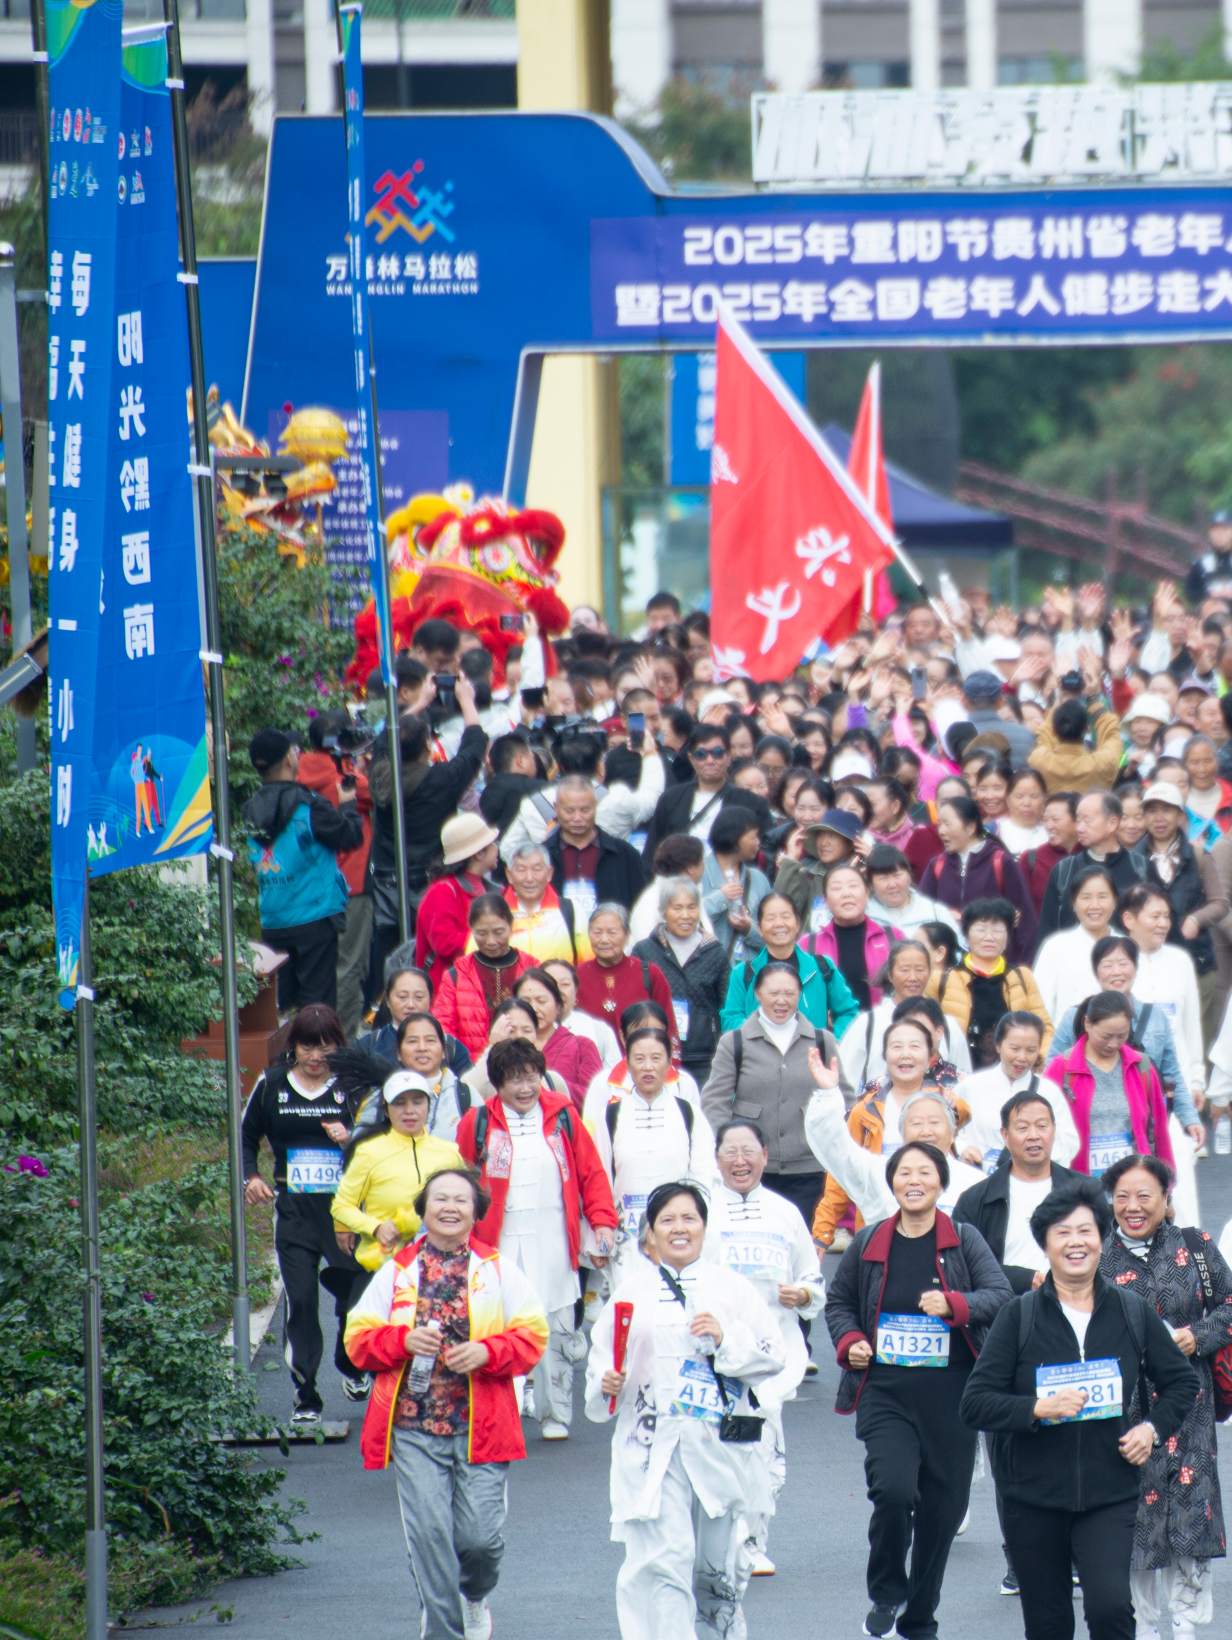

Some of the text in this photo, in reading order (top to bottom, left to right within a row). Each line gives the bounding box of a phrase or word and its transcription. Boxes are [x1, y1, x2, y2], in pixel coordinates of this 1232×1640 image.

[325, 283, 479, 296] WANNGLIN MARATHON
[726, 1245, 784, 1266] A1070
[881, 1334, 943, 1353] A1321
